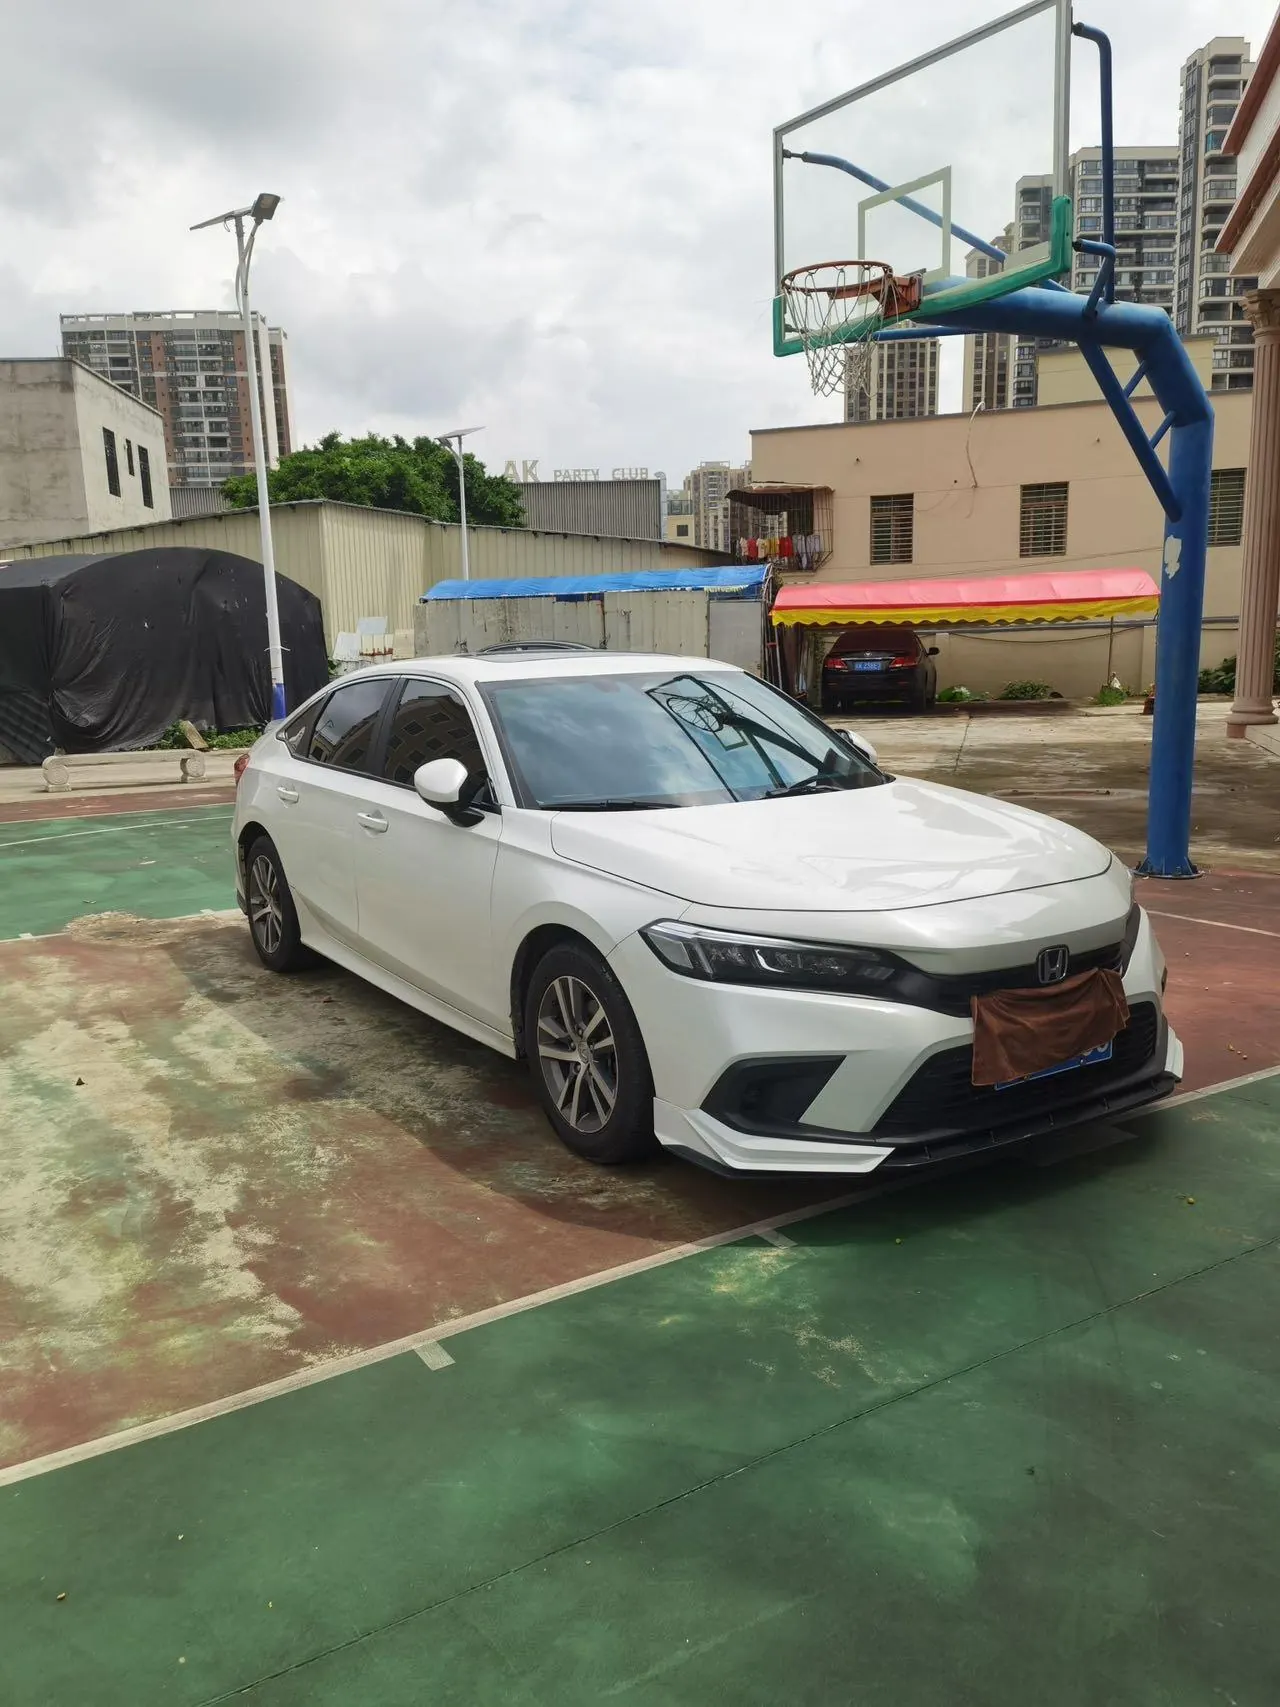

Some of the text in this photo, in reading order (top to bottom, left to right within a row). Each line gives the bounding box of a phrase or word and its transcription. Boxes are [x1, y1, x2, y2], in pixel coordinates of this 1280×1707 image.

[504, 459, 649, 483] AK PARTY CLUB
